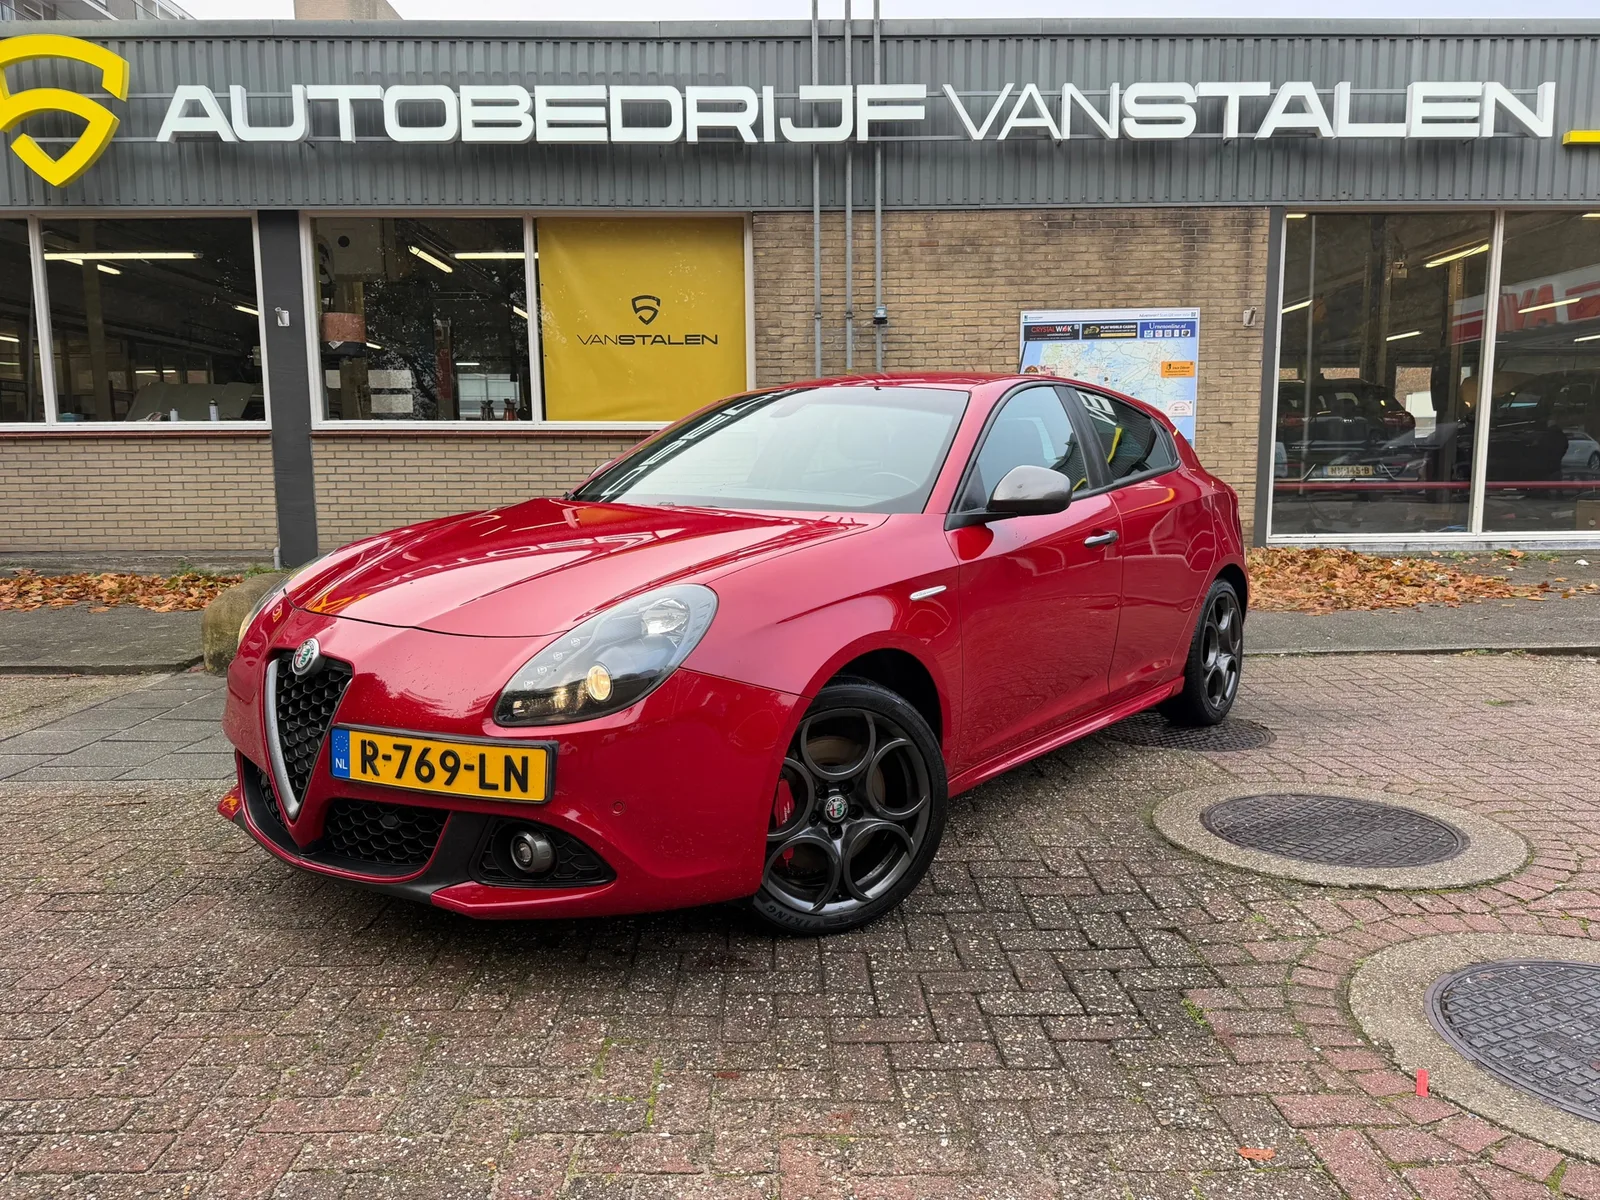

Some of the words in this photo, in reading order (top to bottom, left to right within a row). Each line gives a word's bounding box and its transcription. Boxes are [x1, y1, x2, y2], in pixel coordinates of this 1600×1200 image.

[156, 84, 927, 144] AUTOBEDRIJF
[942, 81, 1556, 141] VANSTALEN
[577, 334, 718, 345] VANSTALEN
[335, 758, 348, 770] NL
[360, 739, 529, 793] R-769-LN
